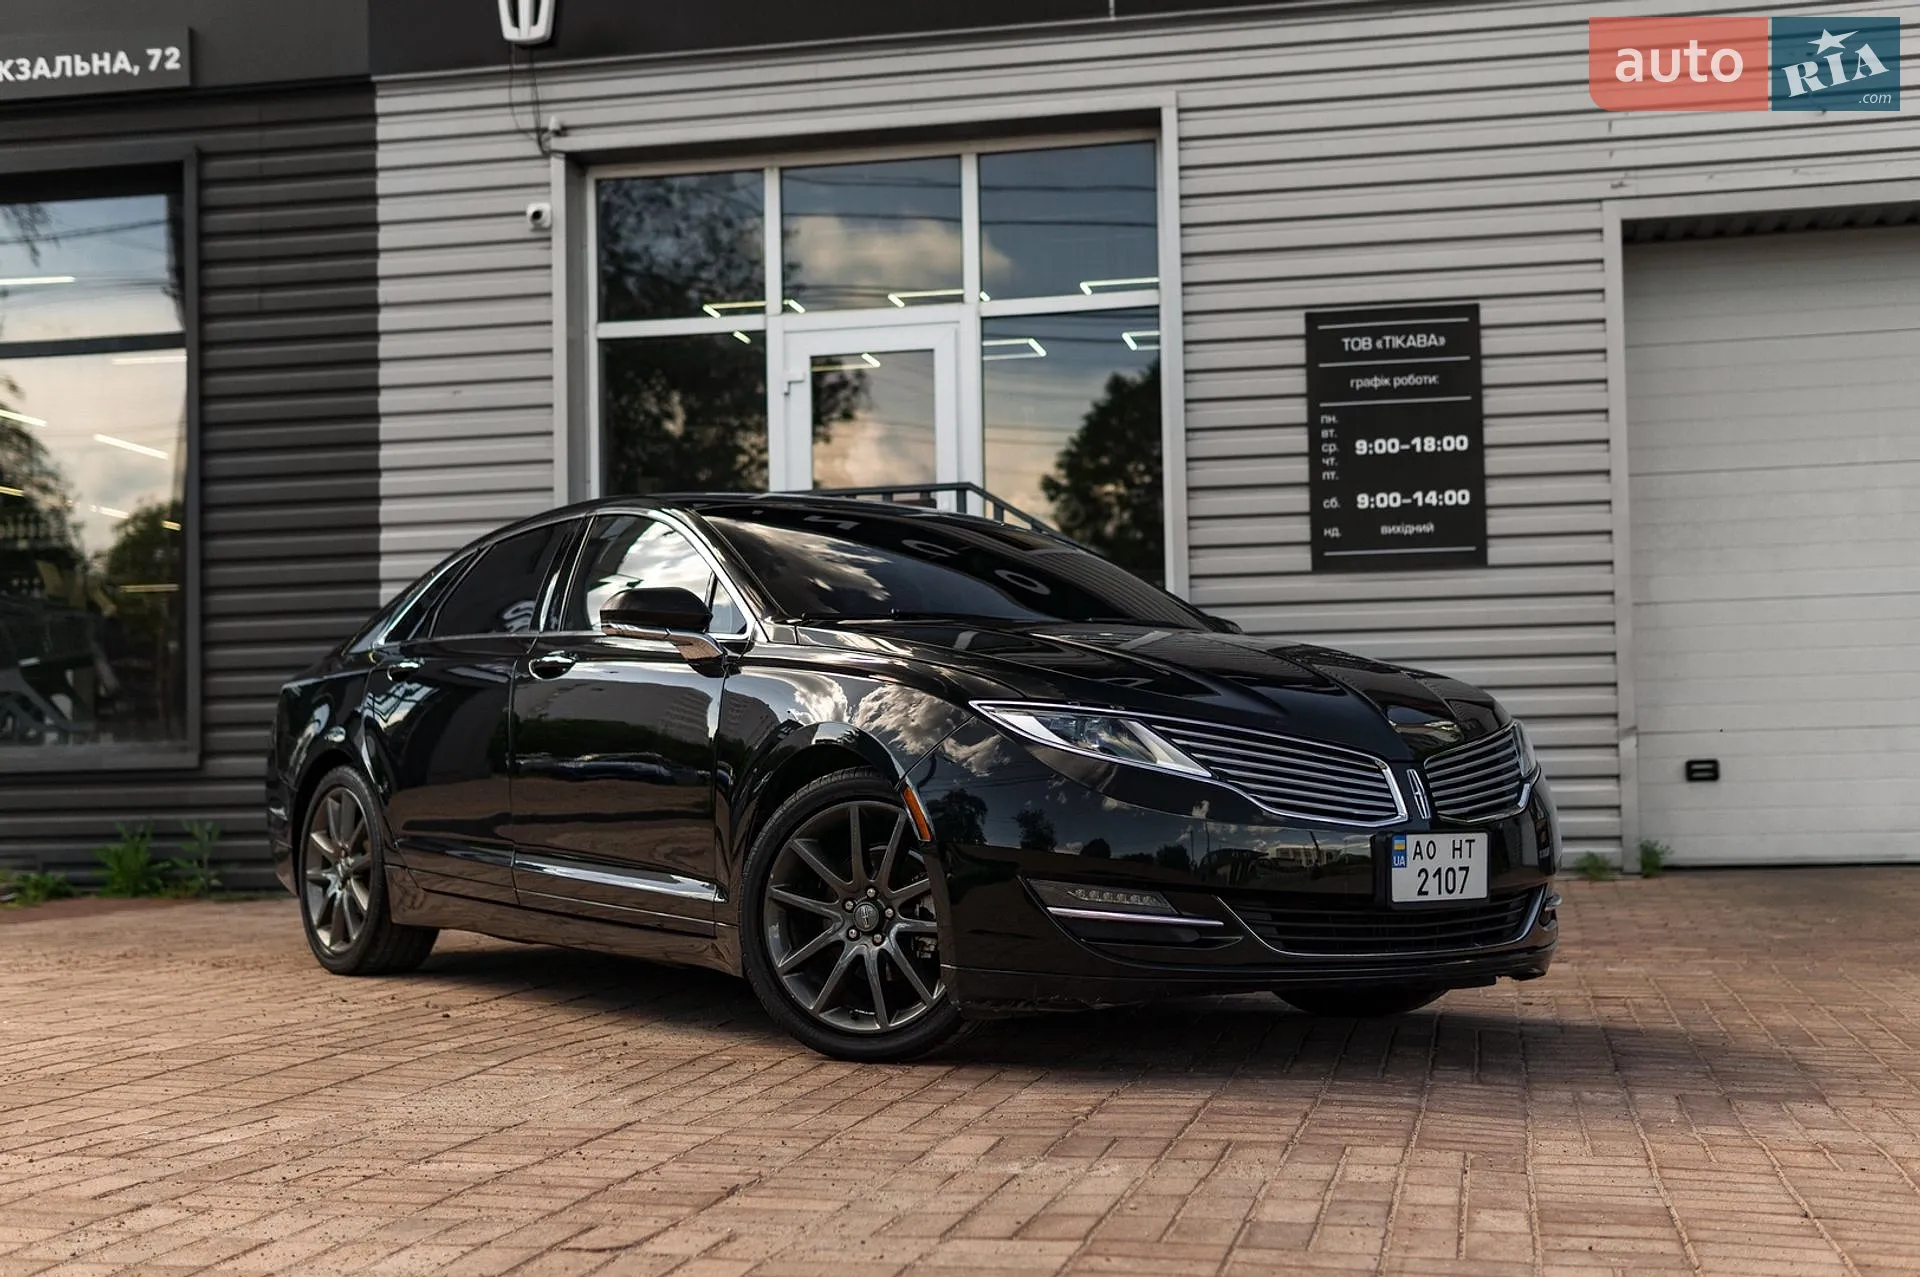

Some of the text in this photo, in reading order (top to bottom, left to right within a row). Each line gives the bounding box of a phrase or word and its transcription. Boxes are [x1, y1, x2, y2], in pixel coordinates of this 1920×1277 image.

[145, 46, 182, 72] 72
[1341, 336, 1373, 352] ТОВ
[1350, 375, 1391, 390] графік
[1380, 522, 1435, 536] вихідний
[1412, 839, 1475, 860] AO HT
[1393, 855, 1406, 866] UA
[1417, 866, 1469, 896] 2107
